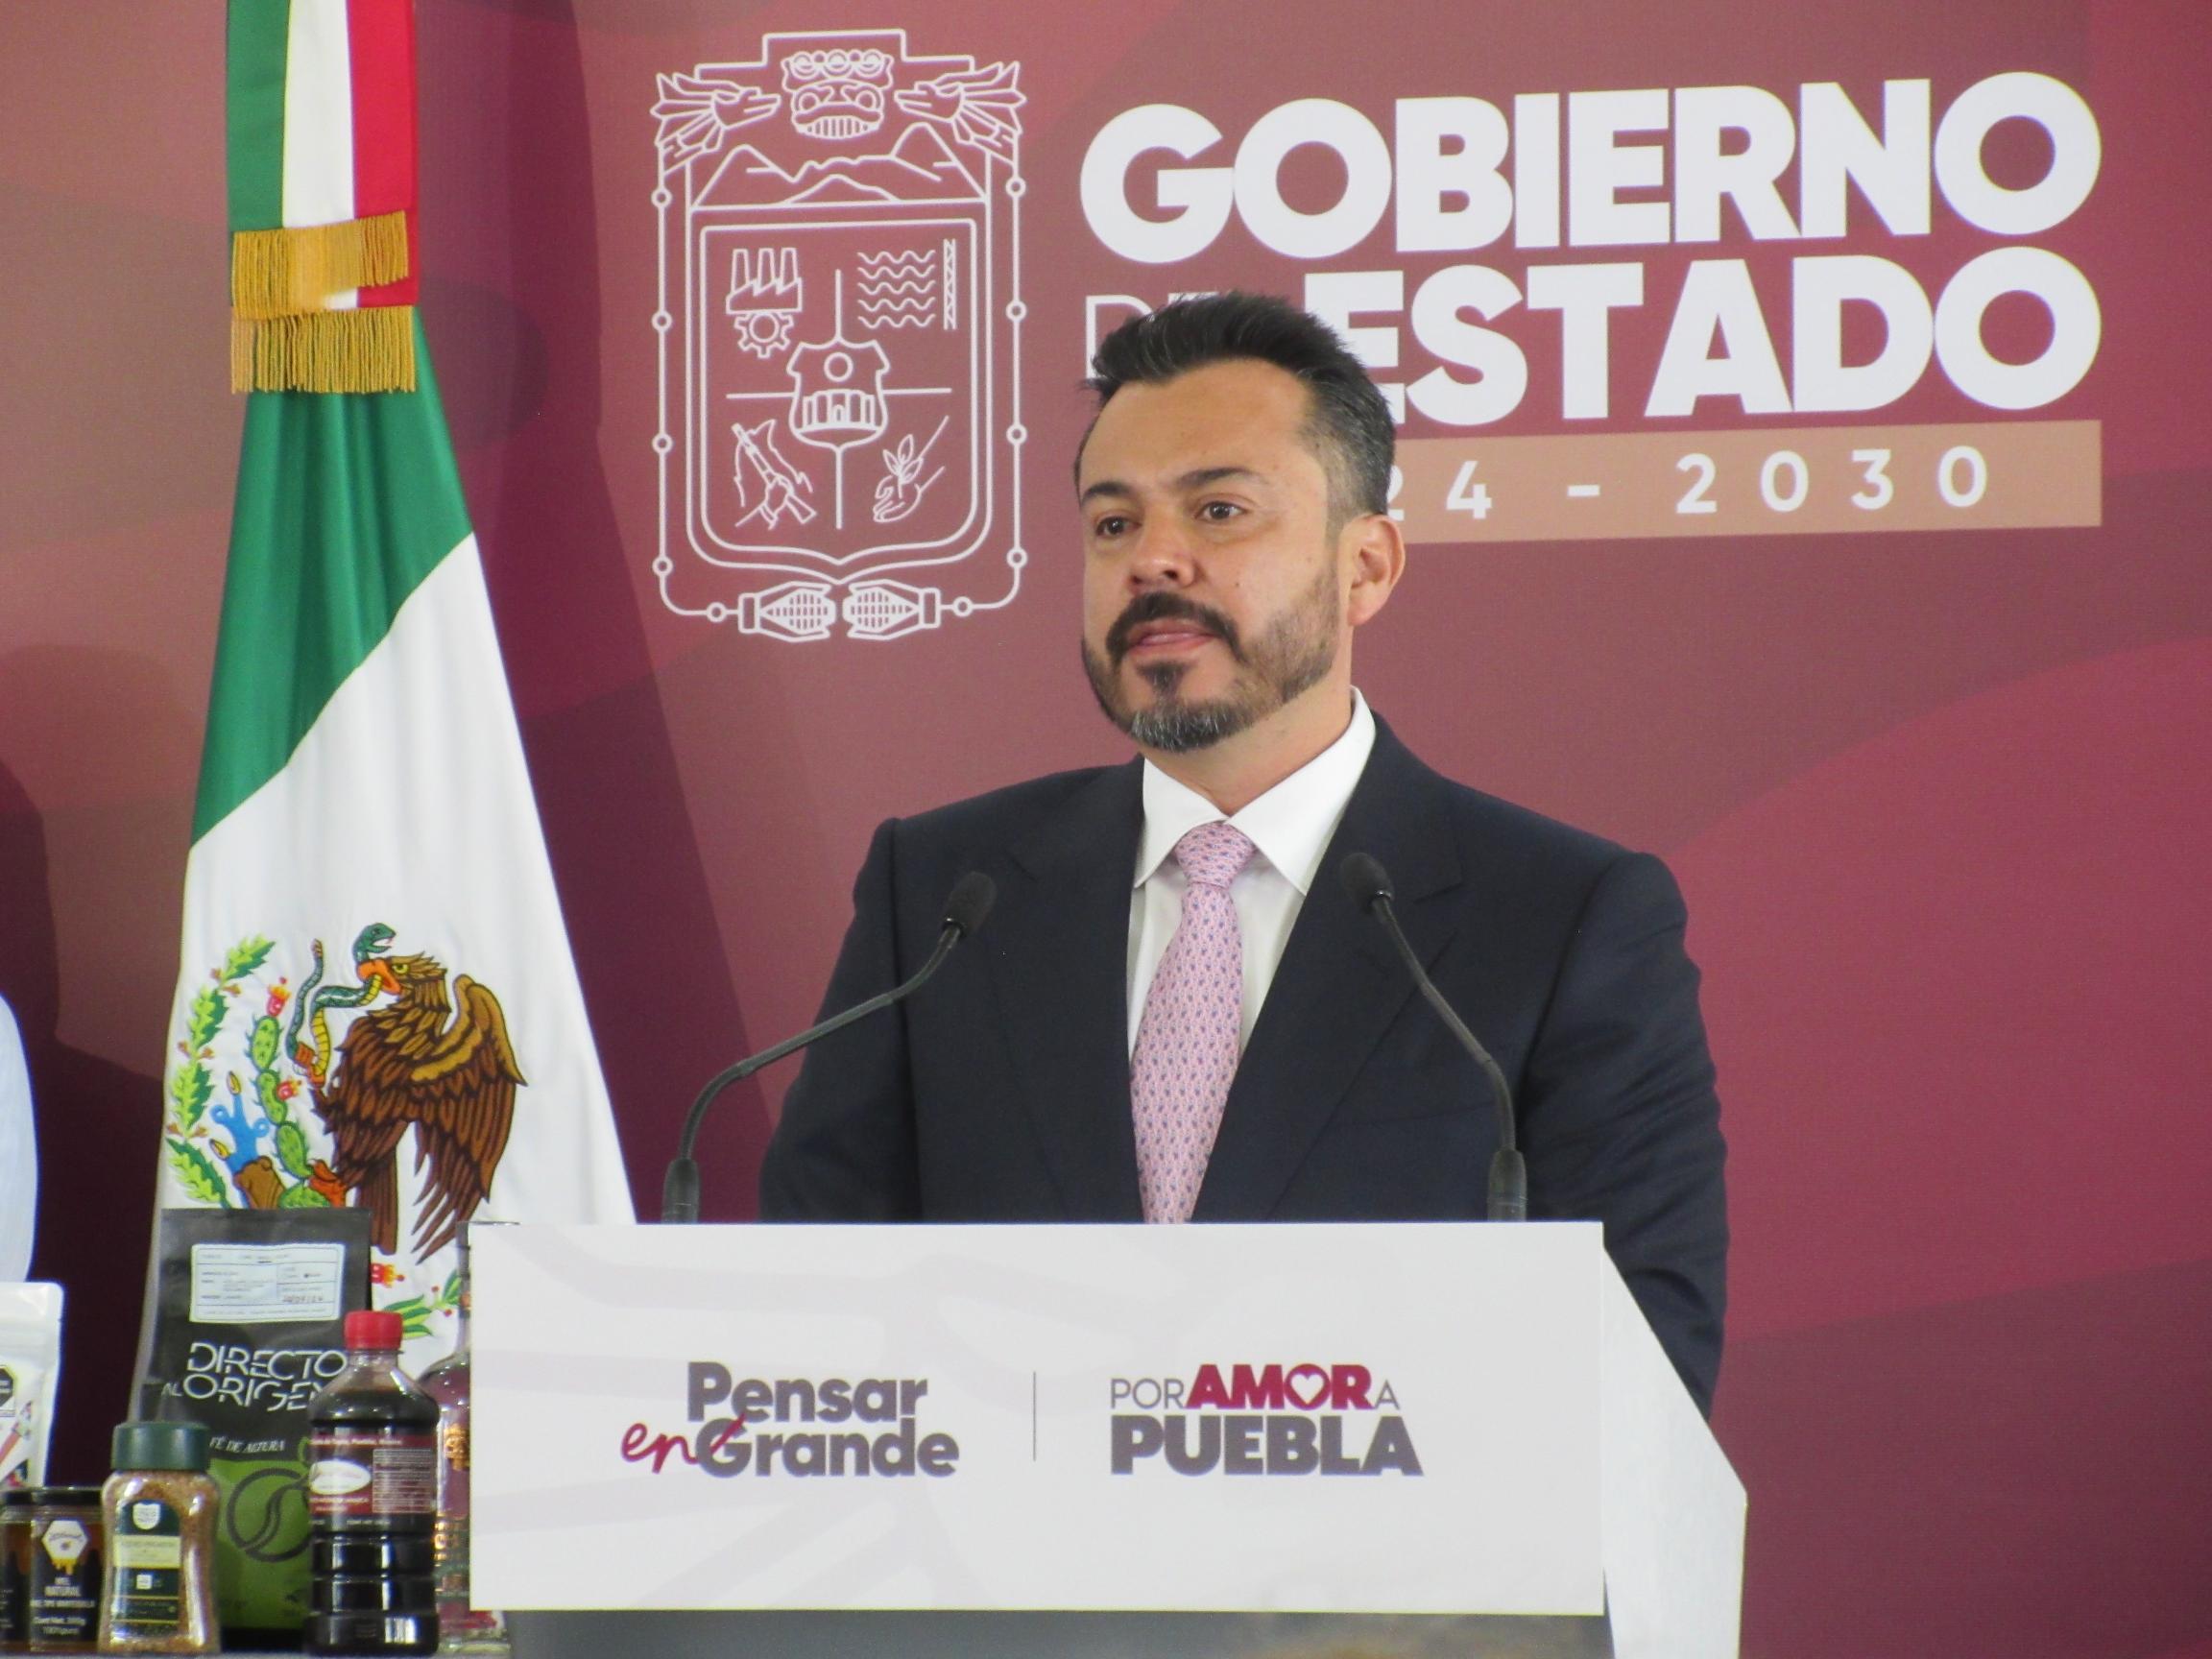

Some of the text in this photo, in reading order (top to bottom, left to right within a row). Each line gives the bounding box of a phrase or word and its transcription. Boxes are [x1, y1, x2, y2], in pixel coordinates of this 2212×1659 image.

[1080, 71, 2103, 264] GOBIERNO
[1305, 245, 2103, 426] ESTADO
[1675, 445, 1988, 515] 2030
[161, 1382, 182, 1398] AL
[187, 1341, 348, 1381] DIRECTO
[686, 1360, 928, 1423] Pensar
[1110, 1377, 1185, 1410] POR
[1184, 1362, 1375, 1411] AMOR
[620, 1416, 960, 1479] en Grande
[1110, 1413, 1425, 1477] PUEBLA
